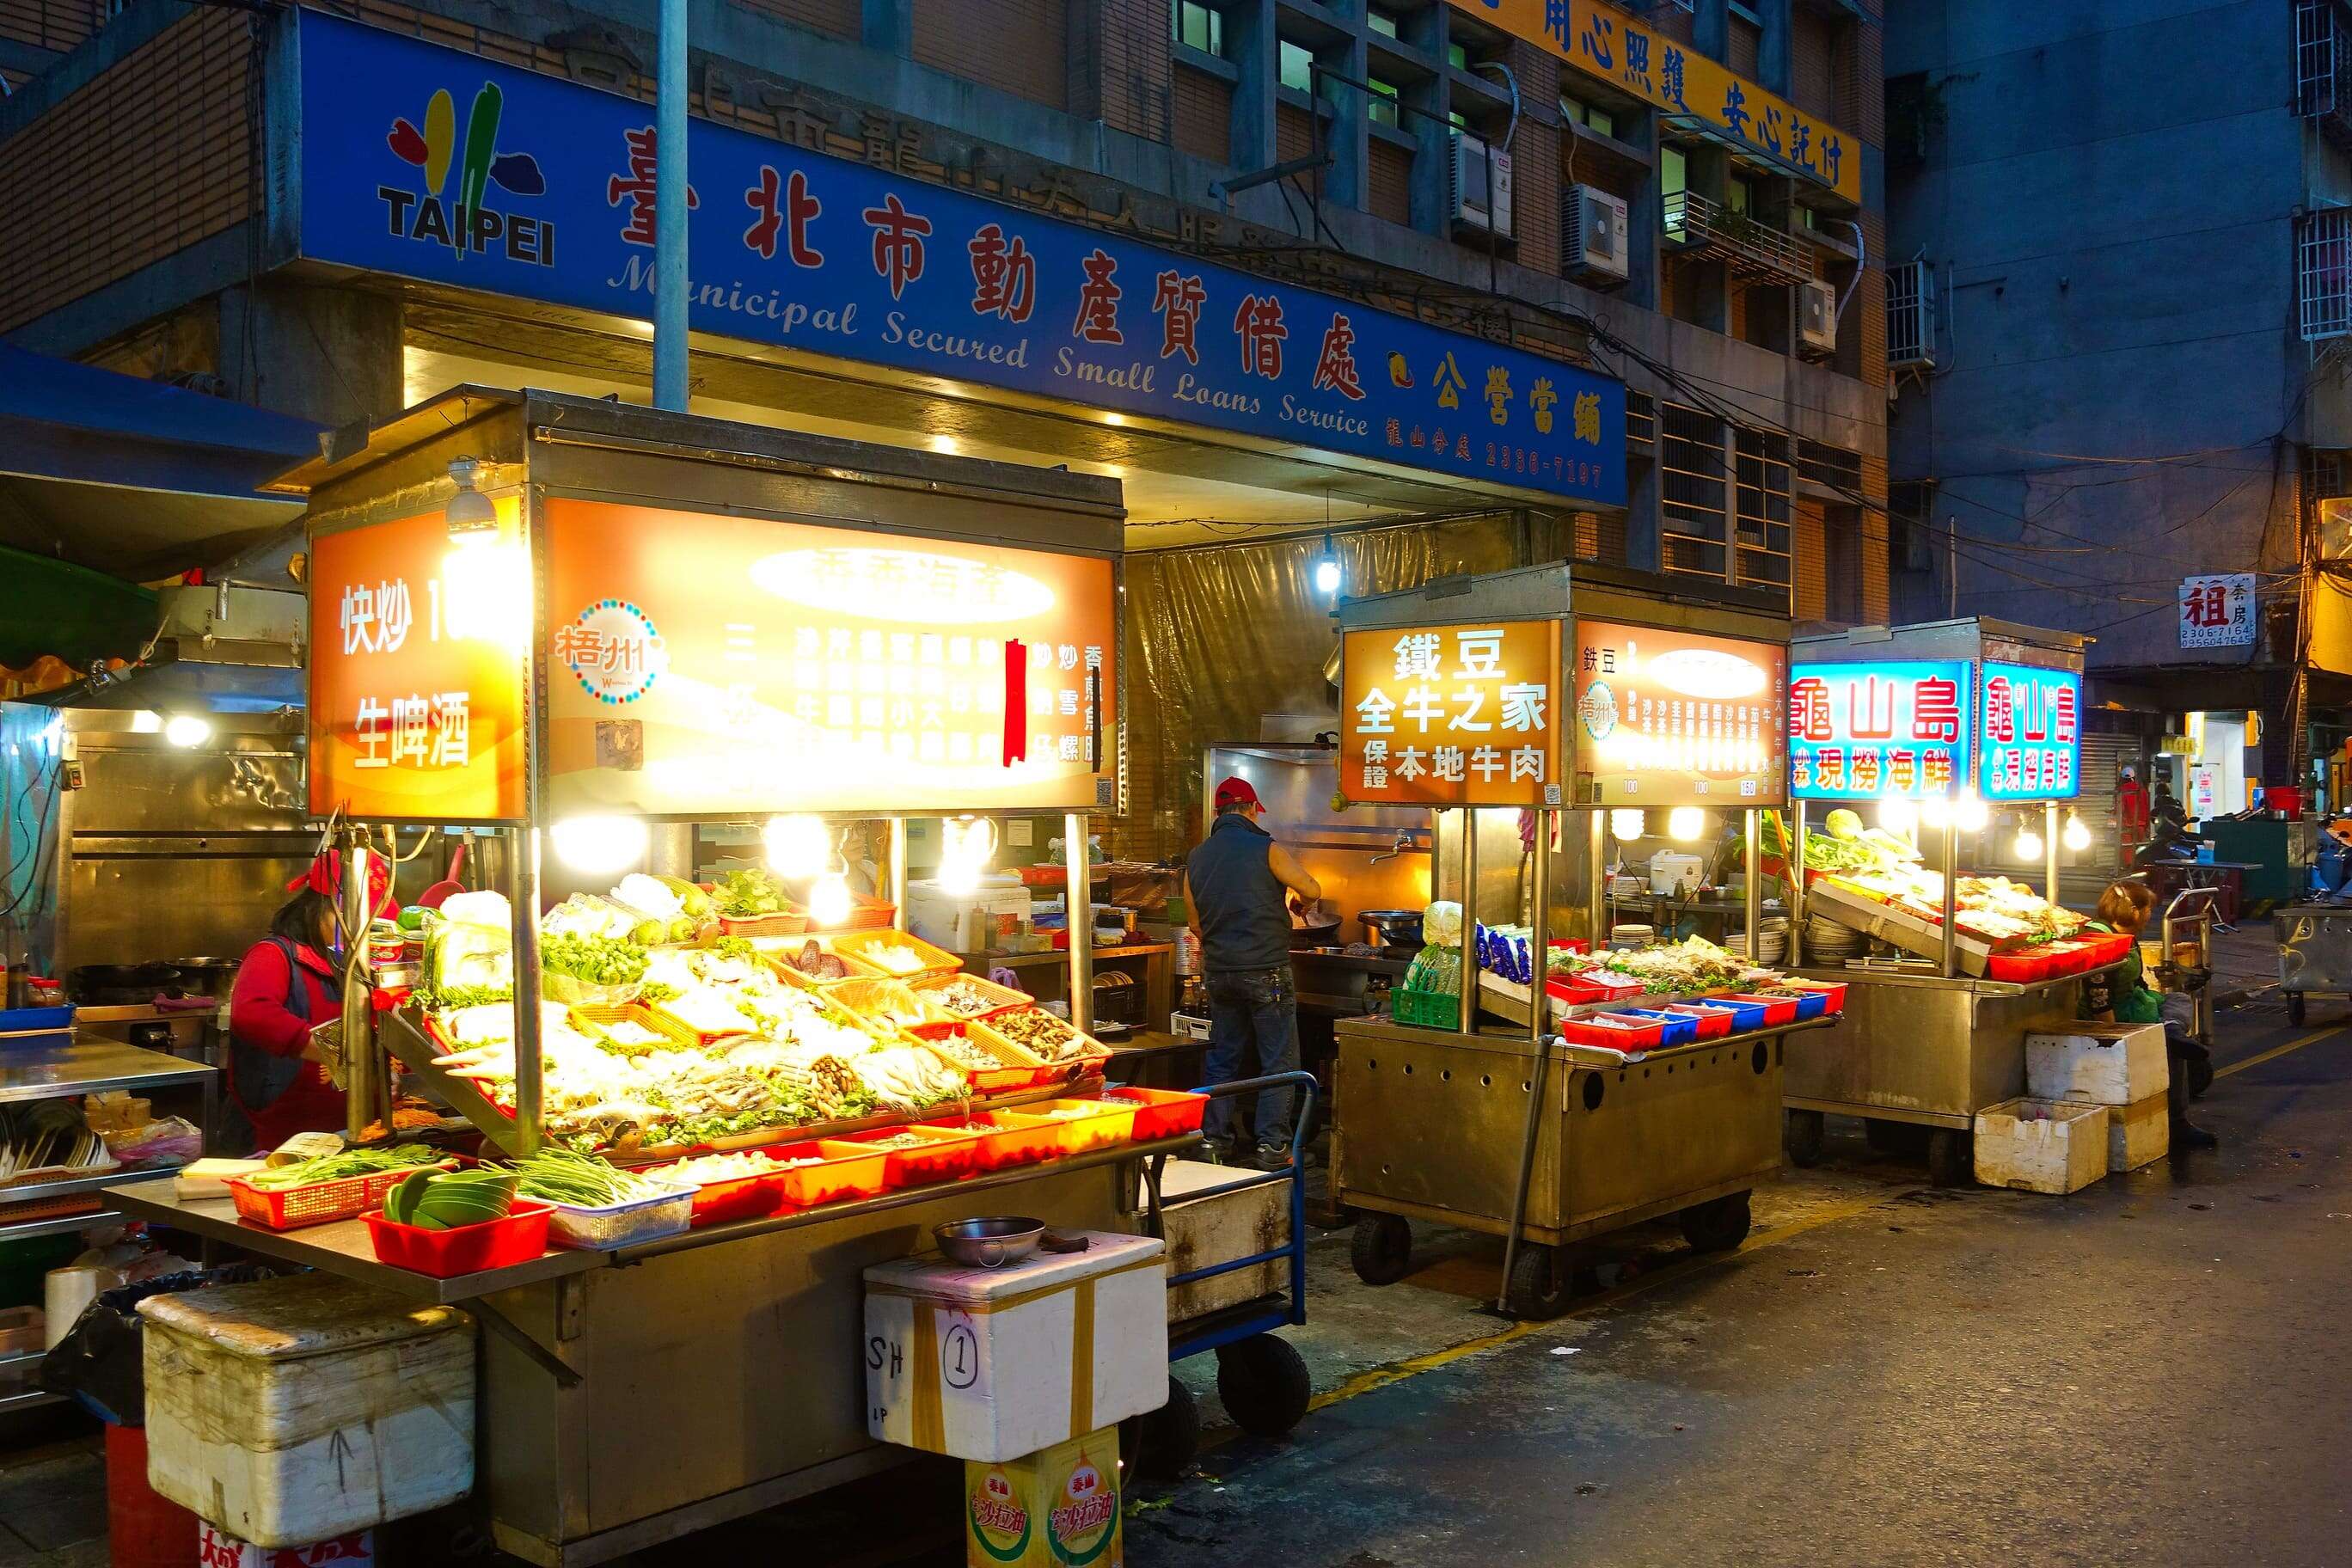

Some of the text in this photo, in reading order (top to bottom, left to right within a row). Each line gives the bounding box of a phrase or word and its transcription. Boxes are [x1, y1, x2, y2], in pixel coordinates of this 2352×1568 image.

[377, 186, 555, 268] TAIPEI
[607, 254, 1369, 437] Mnicipal Secured Small Loans Service
[340, 577, 413, 655] 快炒
[2184, 586, 2229, 628] 租
[1393, 629, 1506, 682] 鐵豆
[354, 691, 470, 769] 生啤酒
[1355, 683, 1547, 735] 全牛之家
[1790, 676, 1960, 744] 龜山島
[1987, 677, 2076, 744] 龜山島
[1363, 739, 1388, 789] 保證
[1393, 744, 1546, 783] 本地牛肉
[1817, 748, 1952, 790] 現撈海鮮
[867, 1336, 903, 1379] SH
[989, 1478, 1009, 1496] 泰山
[1072, 1473, 1095, 1494] 泰山
